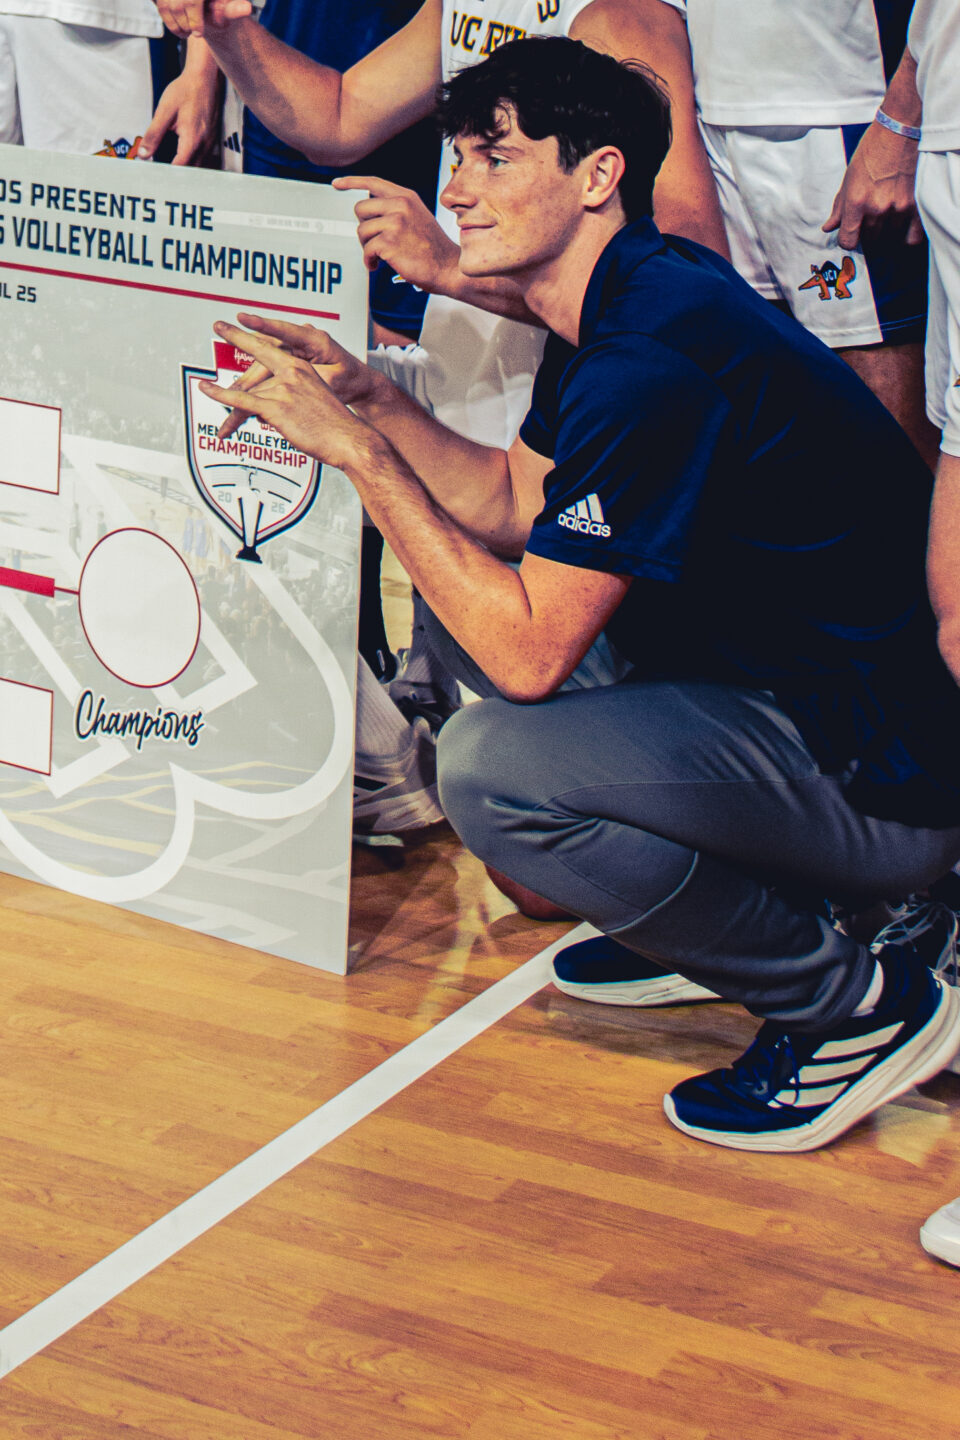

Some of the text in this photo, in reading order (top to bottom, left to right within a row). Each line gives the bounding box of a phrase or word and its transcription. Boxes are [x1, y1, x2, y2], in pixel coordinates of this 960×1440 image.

[450, 10, 483, 52] UC
[30, 183, 156, 222] PRESENTS
[165, 200, 214, 231] THE
[13, 216, 153, 267] VOLLEYBALL
[162, 238, 342, 294] CHAMPIONSHIP
[16, 285, 36, 303] 25
[198, 435, 307, 469] CHAMPIONSHIP
[218, 491, 285, 514] 20 26
[558, 513, 611, 538] adidas
[76, 690, 204, 750] Champions
